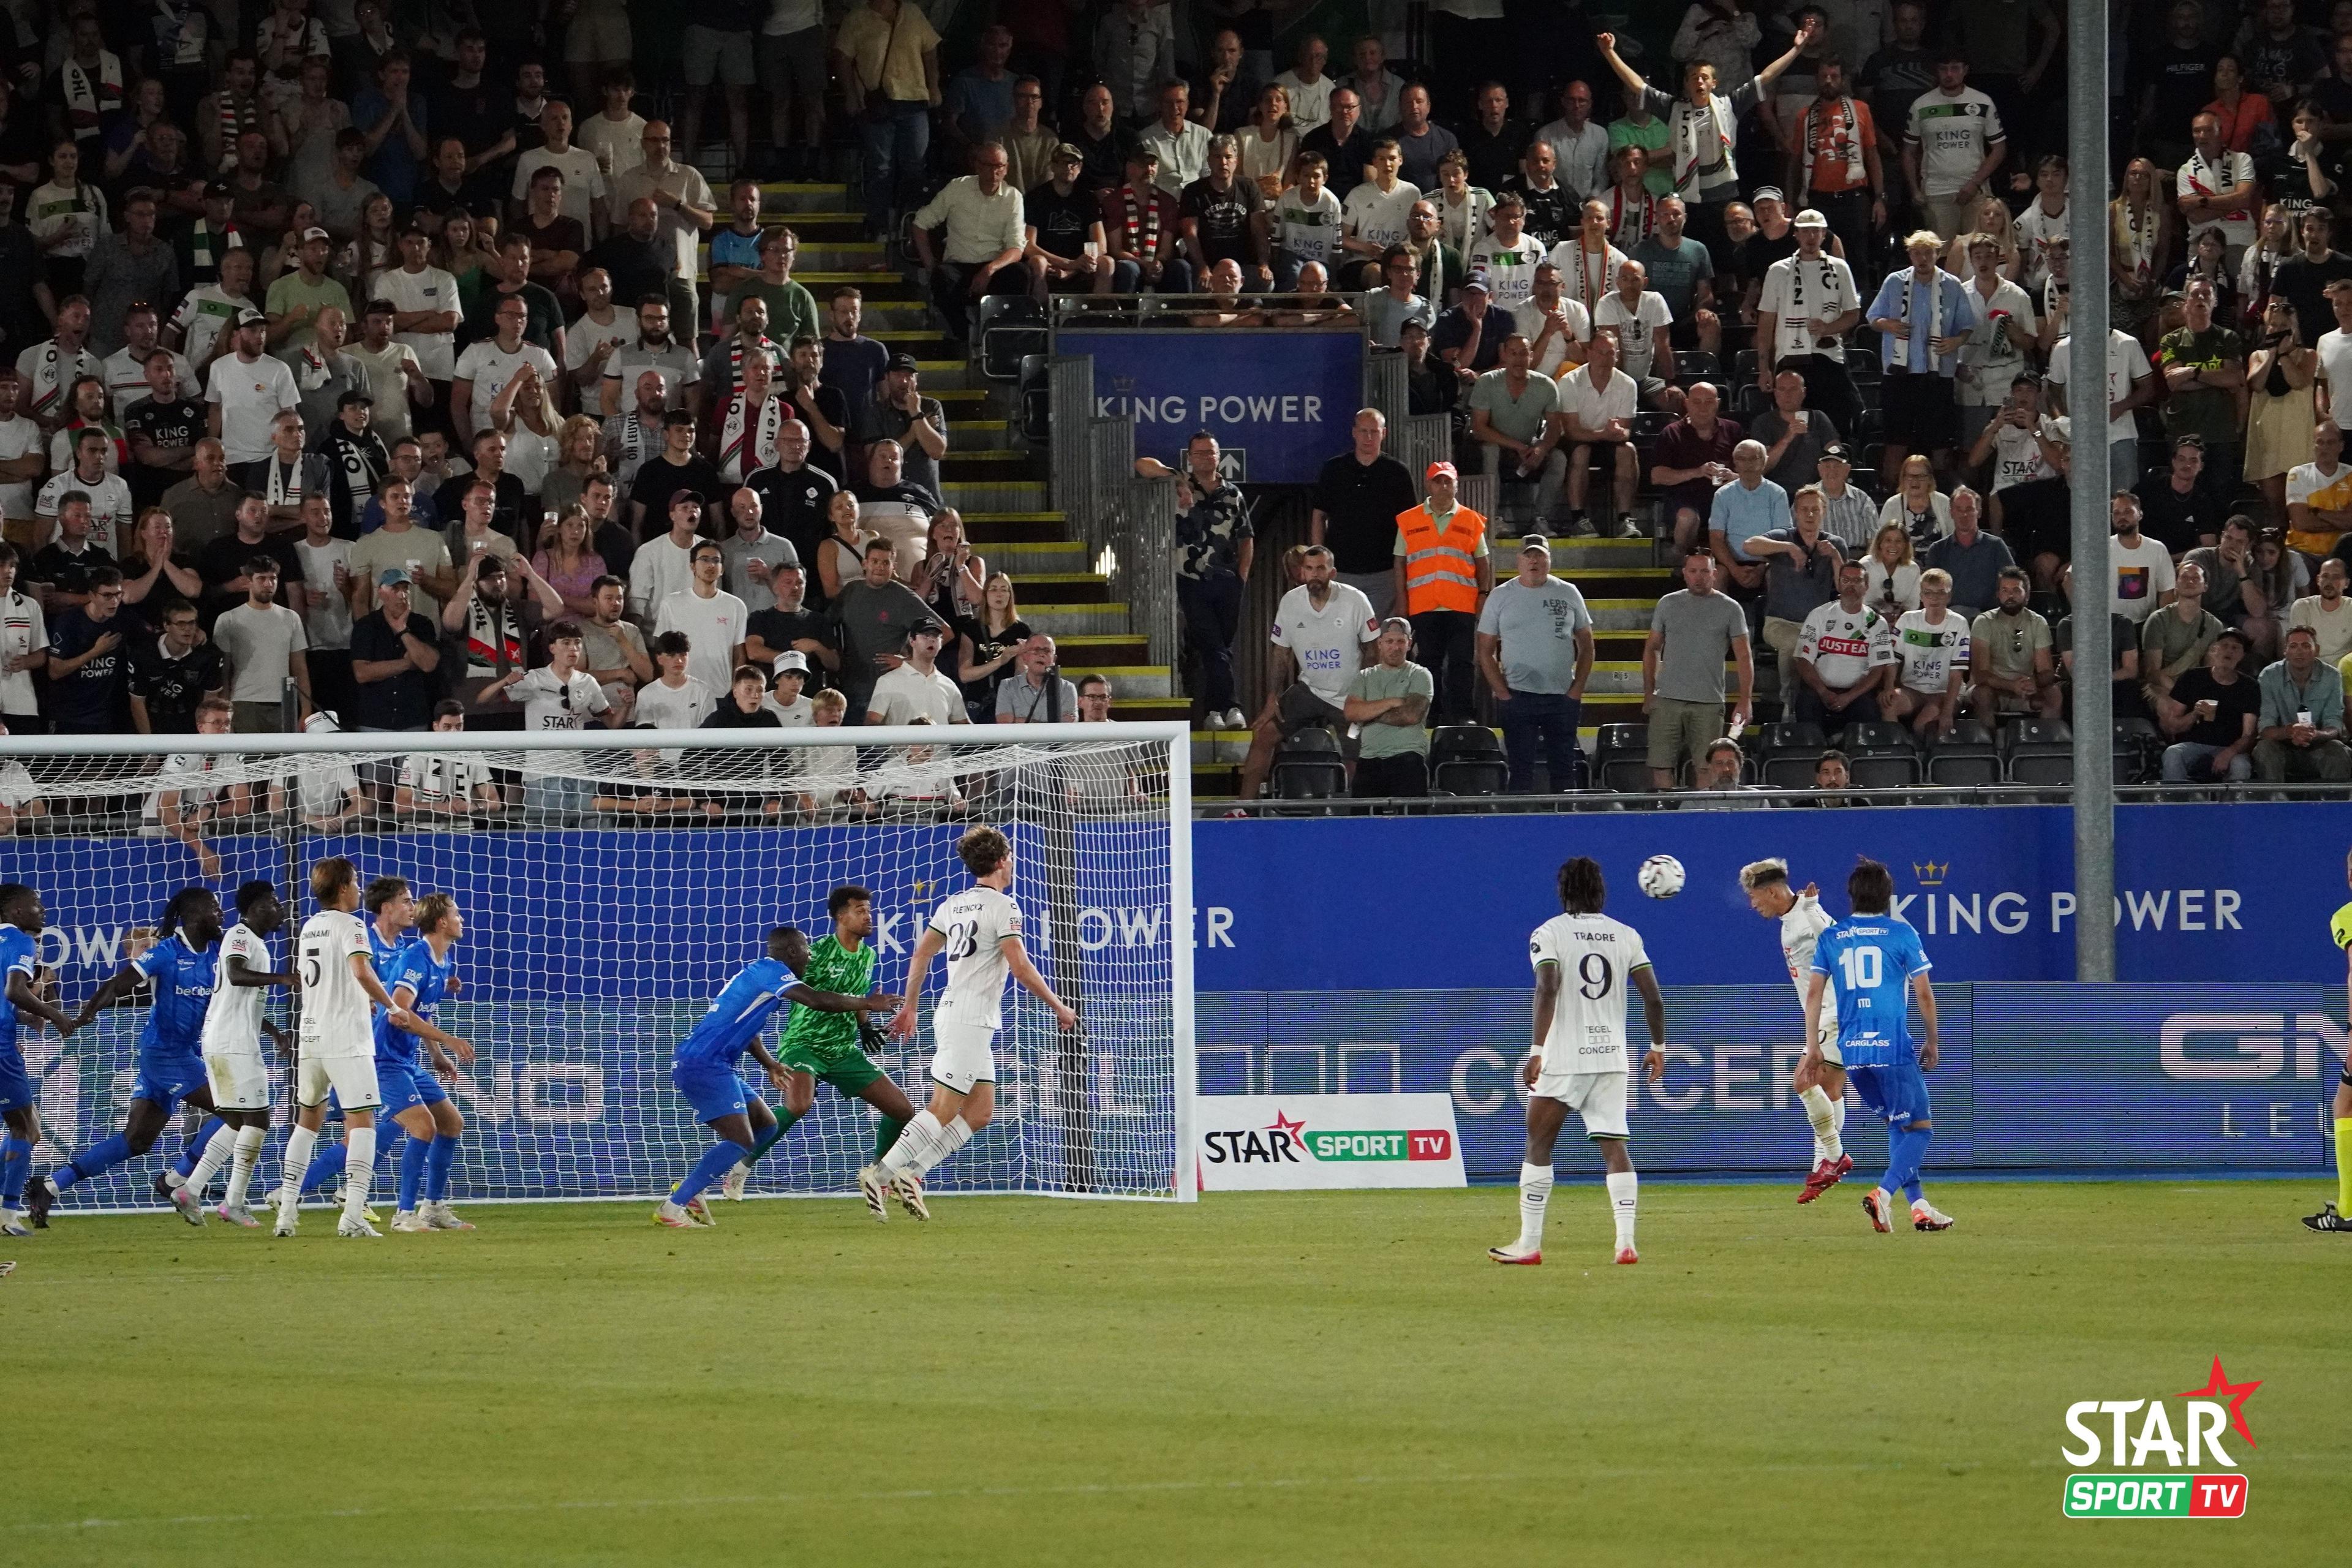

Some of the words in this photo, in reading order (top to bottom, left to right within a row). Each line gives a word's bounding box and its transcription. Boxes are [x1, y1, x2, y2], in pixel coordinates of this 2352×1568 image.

[1937, 129, 1971, 141] KING
[1937, 140, 1971, 149] POWER
[2279, 197, 2313, 209] KING
[1499, 279, 1529, 290] KING
[1097, 396, 1186, 424] KING
[1200, 395, 1322, 423] POWER
[627, 410, 639, 443] LEUVEN
[155, 426, 189, 440] KING
[627, 447, 638, 461] OH
[2002, 461, 2035, 476] STAR
[1542, 599, 1568, 609] AERO
[1820, 638, 1849, 653] JUST
[1305, 649, 1341, 660] KING
[1306, 661, 1341, 670] POWER
[1913, 661, 1942, 671] KING
[543, 714, 573, 729] STAR
[1889, 892, 2030, 936] KING
[2052, 889, 2244, 933] PWER
[948, 919, 979, 962] 28
[1573, 932, 1616, 942] TRAORE
[1836, 929, 1856, 940] STAR
[304, 948, 321, 988] 5
[1838, 946, 1883, 991] 10
[1579, 953, 1612, 1000] 9
[1858, 998, 1871, 1008] ITO
[1585, 1025, 1612, 1034] TEGEL
[1845, 1039, 1890, 1048] CARGLASS
[1578, 1045, 1621, 1055] CONCEPT
[1205, 1130, 1302, 1164] STAR
[1316, 1136, 1404, 1156] SPORT
[1414, 1136, 1445, 1154] TV
